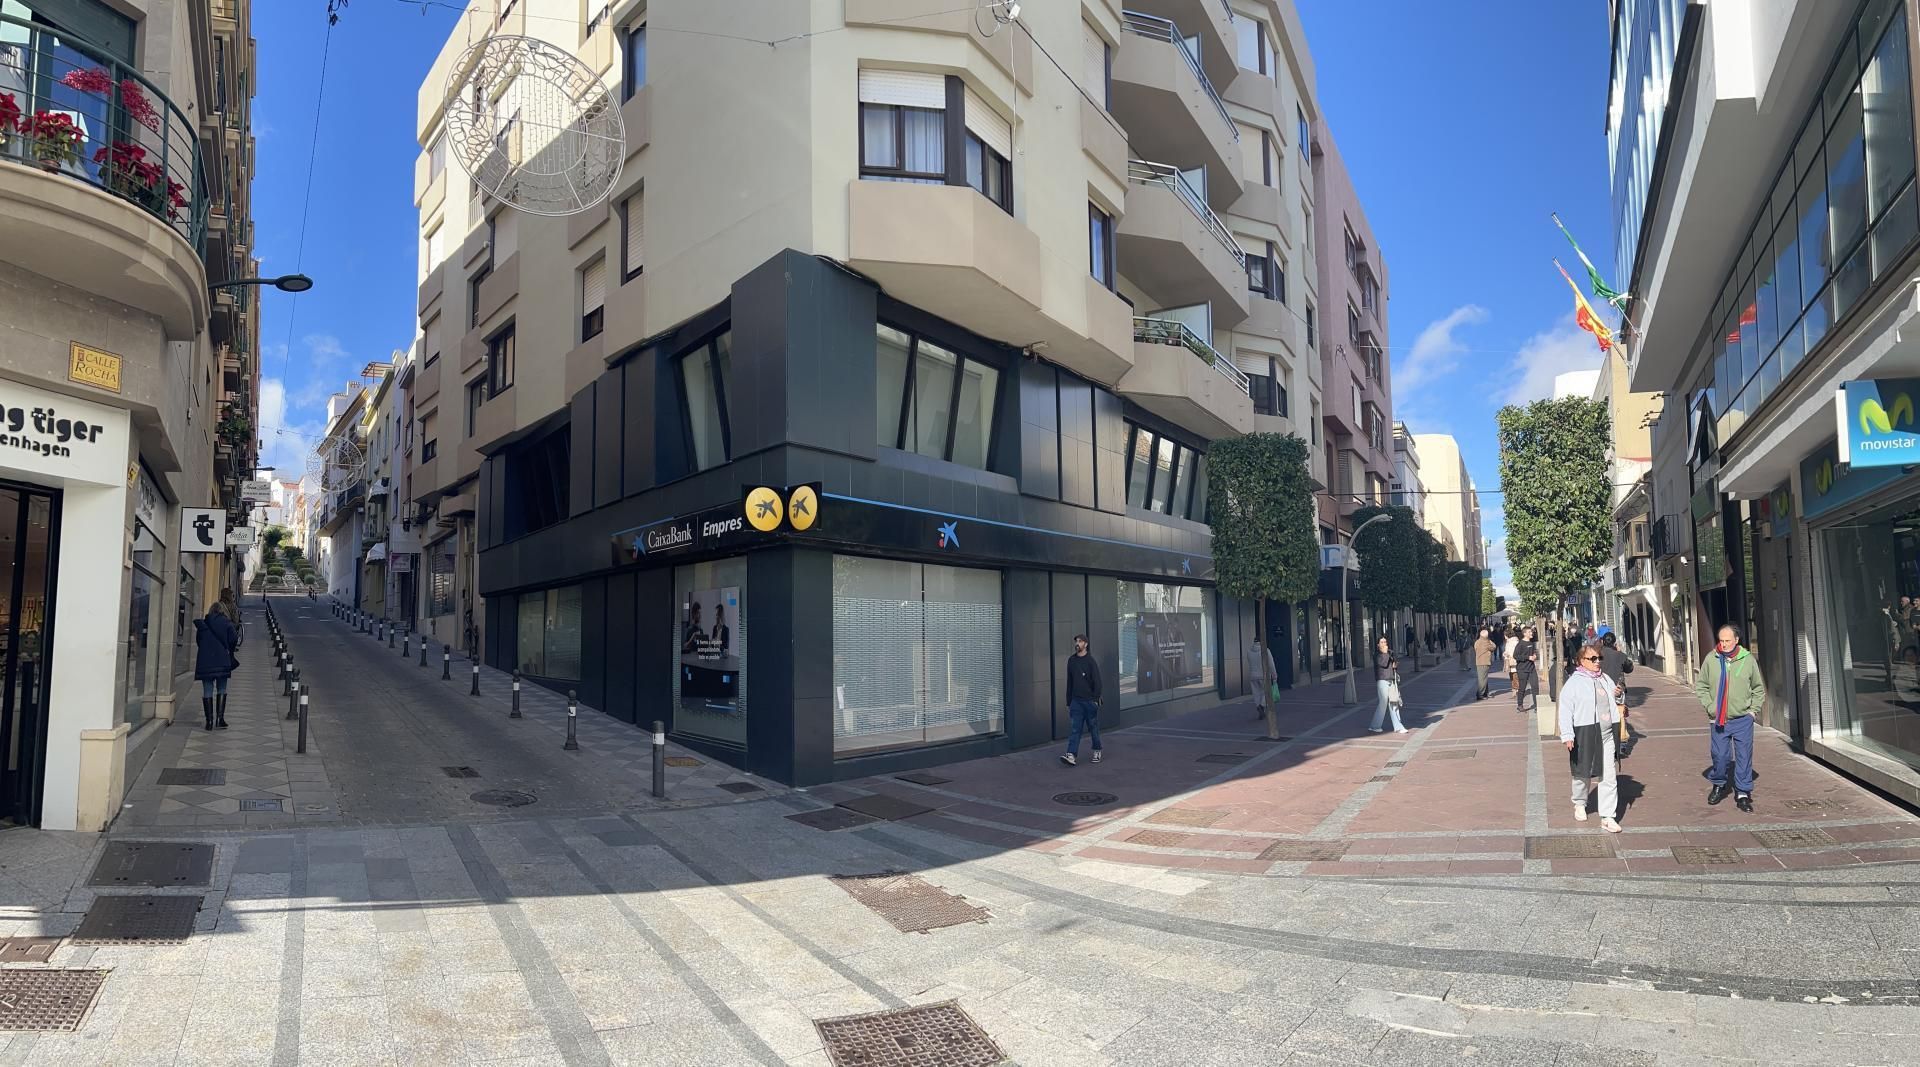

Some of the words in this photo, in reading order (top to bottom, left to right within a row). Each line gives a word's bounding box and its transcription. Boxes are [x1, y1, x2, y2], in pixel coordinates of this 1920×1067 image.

[75, 361, 117, 382] ROCHA
[85, 353, 117, 369] CALLE
[31, 407, 103, 443] tiger
[1860, 438, 1917, 451] movistar
[648, 522, 692, 549] CaixaBank
[703, 516, 743, 538] Empres
